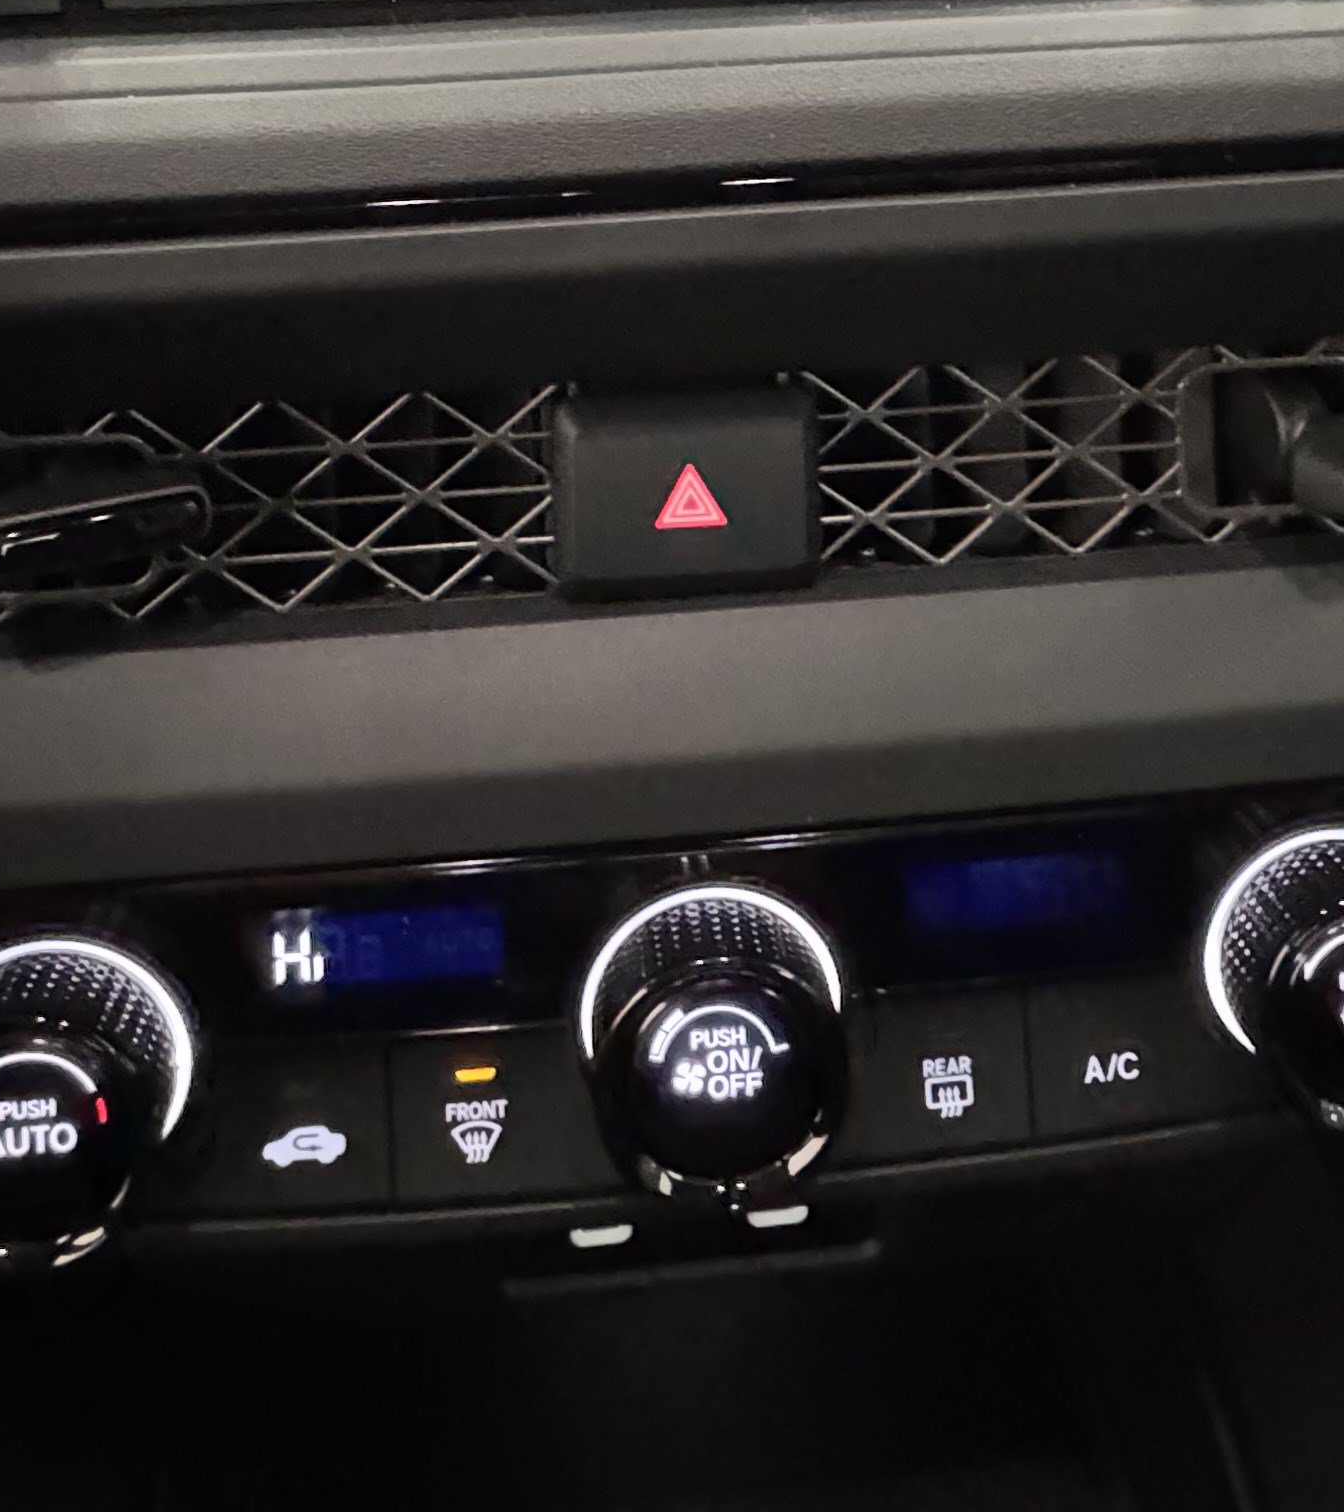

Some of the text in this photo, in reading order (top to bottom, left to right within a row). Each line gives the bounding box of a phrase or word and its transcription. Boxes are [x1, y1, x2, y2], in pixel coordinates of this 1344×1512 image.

[689, 1025, 748, 1051] PUSH
[705, 1045, 763, 1074] ON/
[922, 1055, 973, 1078] REAR
[1083, 1051, 1141, 1085] A/C
[705, 1068, 764, 1100] OFF
[445, 1099, 509, 1123] FRONT
